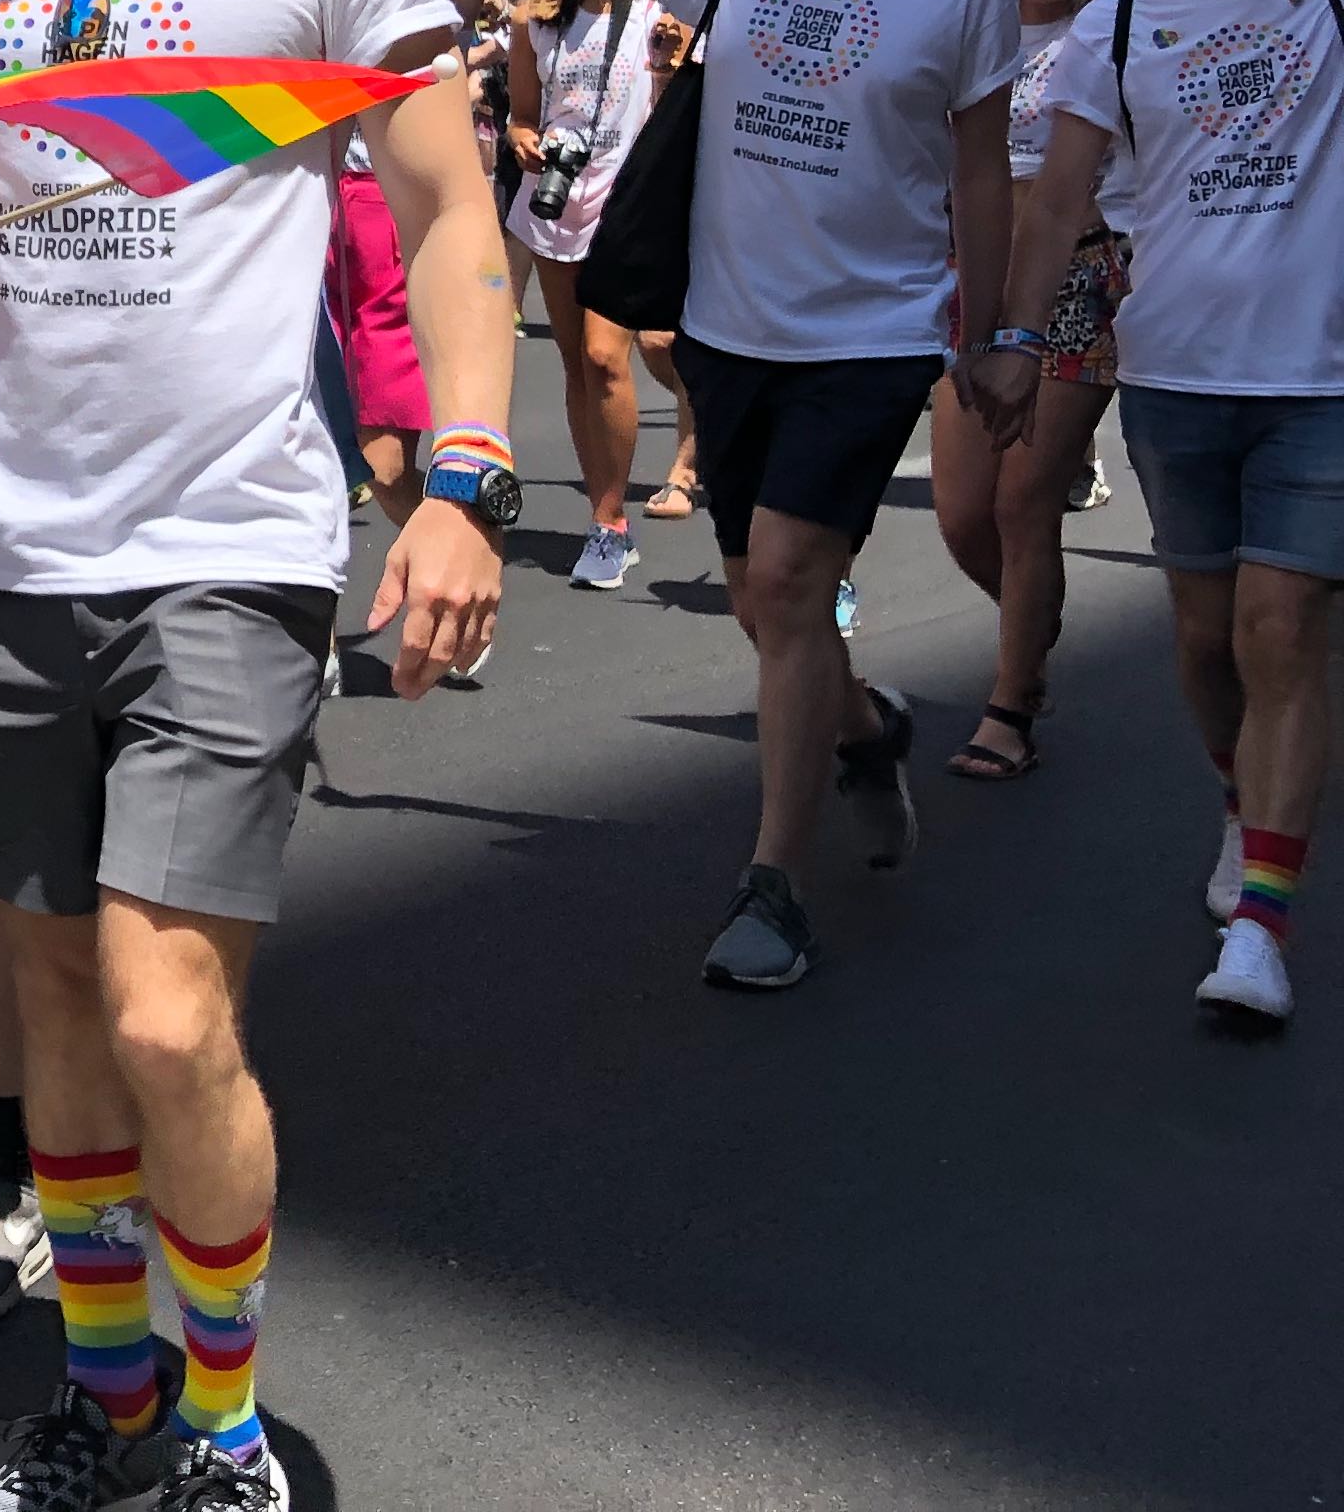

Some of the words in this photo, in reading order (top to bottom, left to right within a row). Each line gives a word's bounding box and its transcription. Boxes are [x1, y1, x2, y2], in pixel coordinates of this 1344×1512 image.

[792, 4, 844, 24] COPEN
[787, 16, 840, 36] HAGEN
[782, 29, 833, 53] 2021
[1216, 58, 1274, 79] COPEN
[1217, 71, 1275, 92] HAGEN
[762, 91, 825, 112] CELEBRATING
[1220, 85, 1275, 109] 2021
[736, 100, 851, 138] WORLDPRIDE
[733, 146, 840, 178] #YouAreIncluded
[0, 284, 171, 307] #YouAreIncluded
